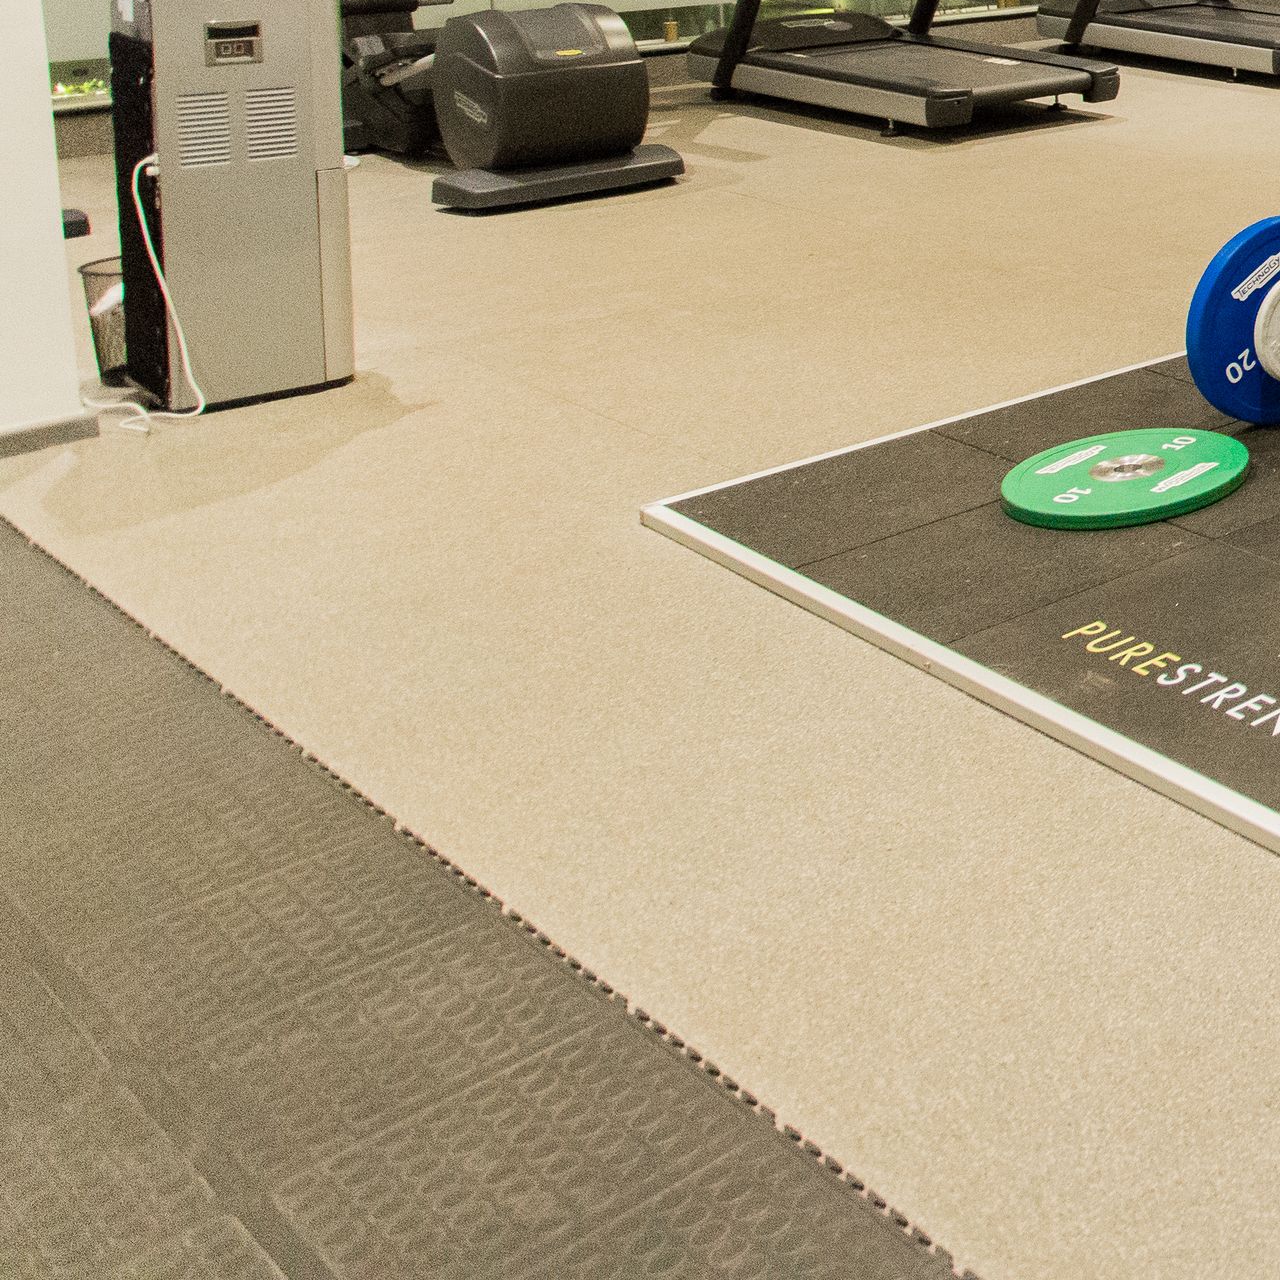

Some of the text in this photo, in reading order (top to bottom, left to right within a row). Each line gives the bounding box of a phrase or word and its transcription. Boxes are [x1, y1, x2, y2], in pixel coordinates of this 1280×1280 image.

[1226, 348, 1256, 384] 20
[1162, 436, 1197, 452] 10
[1053, 487, 1091, 503] 10
